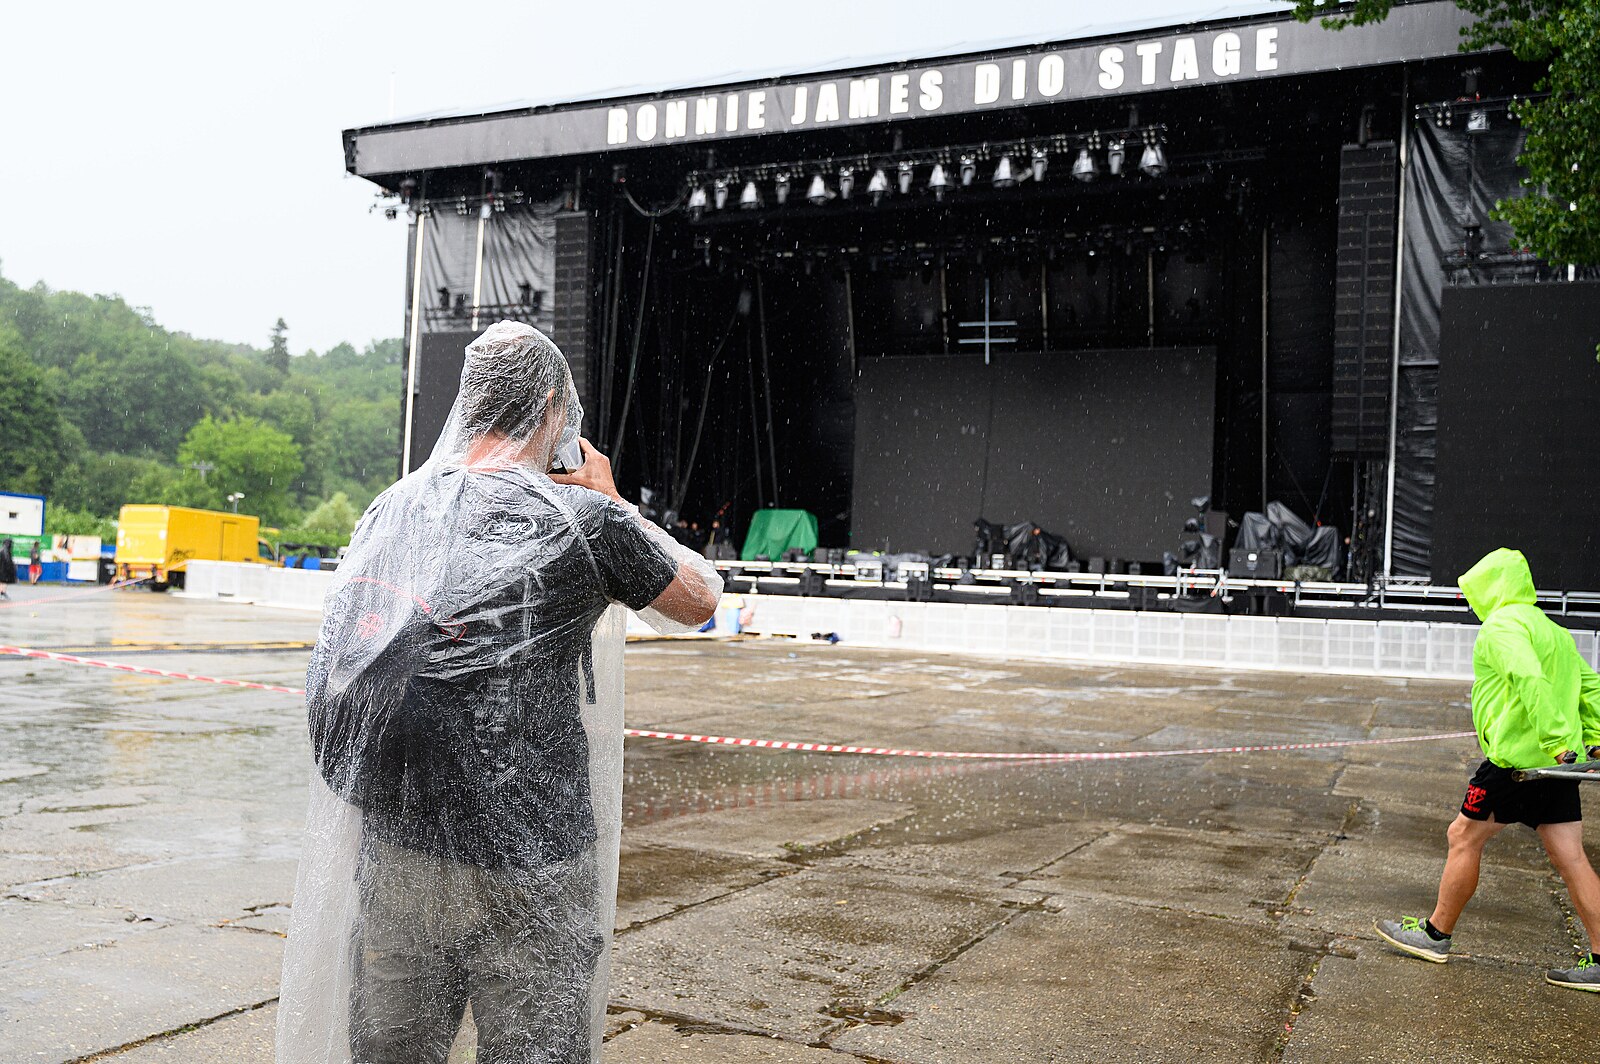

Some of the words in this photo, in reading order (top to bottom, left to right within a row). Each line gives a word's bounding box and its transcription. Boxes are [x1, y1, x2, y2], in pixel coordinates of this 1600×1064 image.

[607, 90, 767, 146] RONNIE
[790, 69, 944, 126] JAMES
[974, 54, 1065, 105] DIO
[1098, 26, 1280, 91] STAGE
